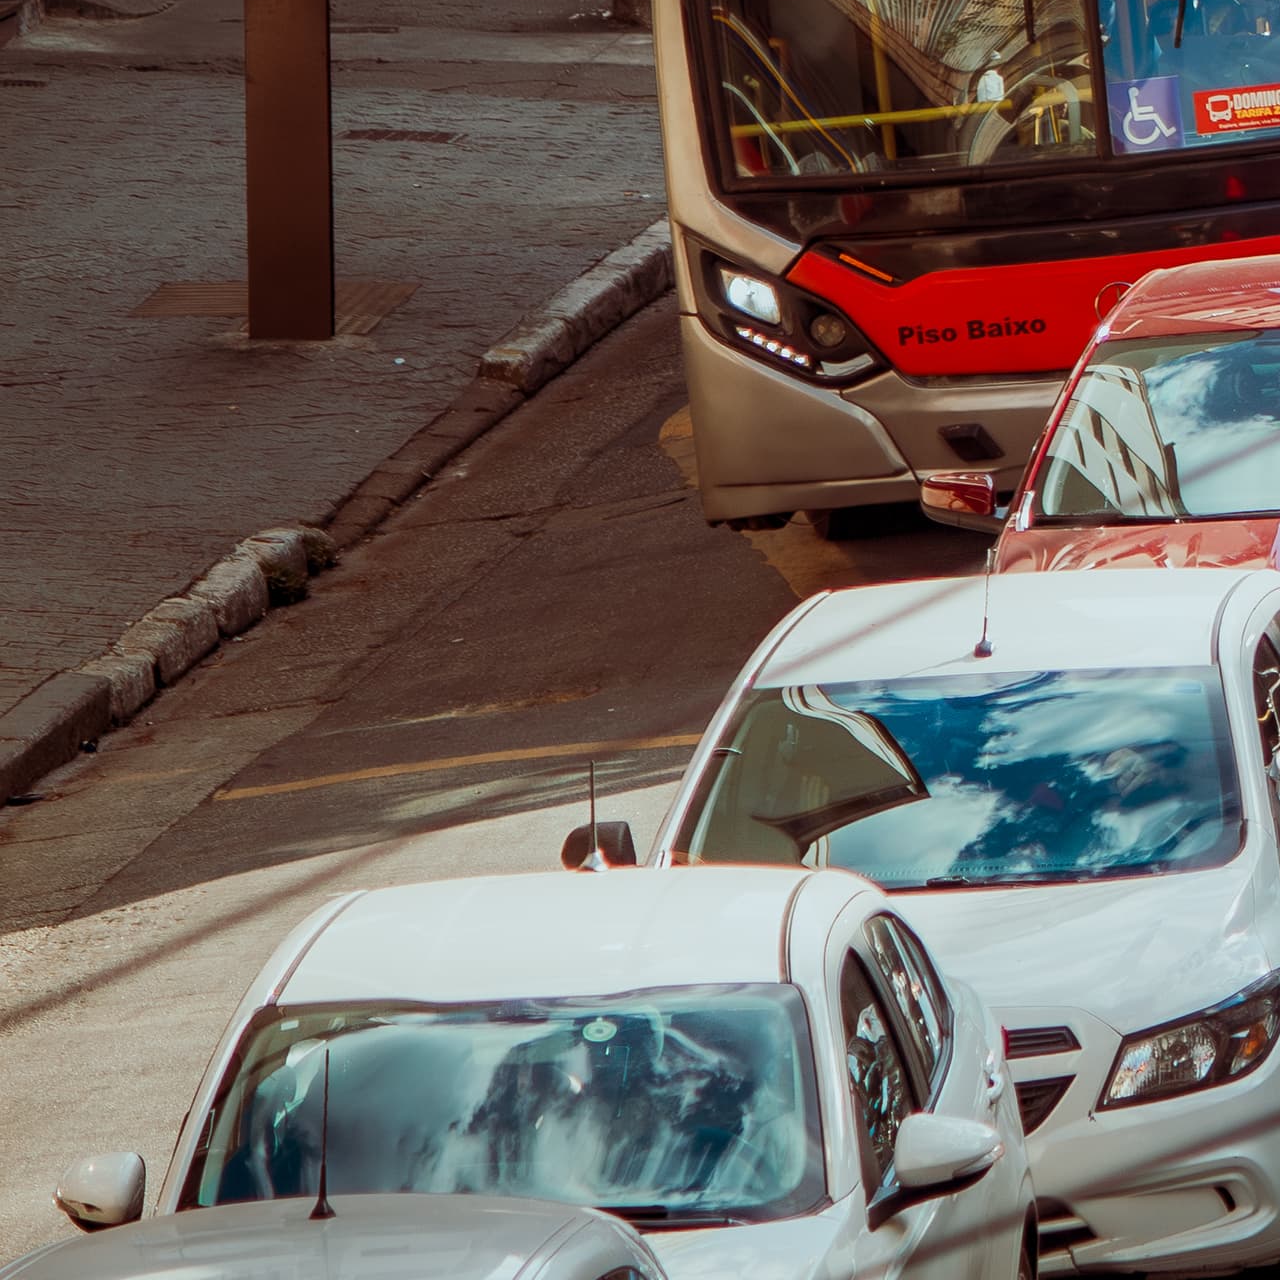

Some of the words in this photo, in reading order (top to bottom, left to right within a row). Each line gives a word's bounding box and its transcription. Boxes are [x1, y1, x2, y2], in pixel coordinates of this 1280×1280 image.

[1235, 108, 1272, 119] TARIFA
[898, 325, 958, 346] Piso
[966, 317, 1047, 340] Baixo
